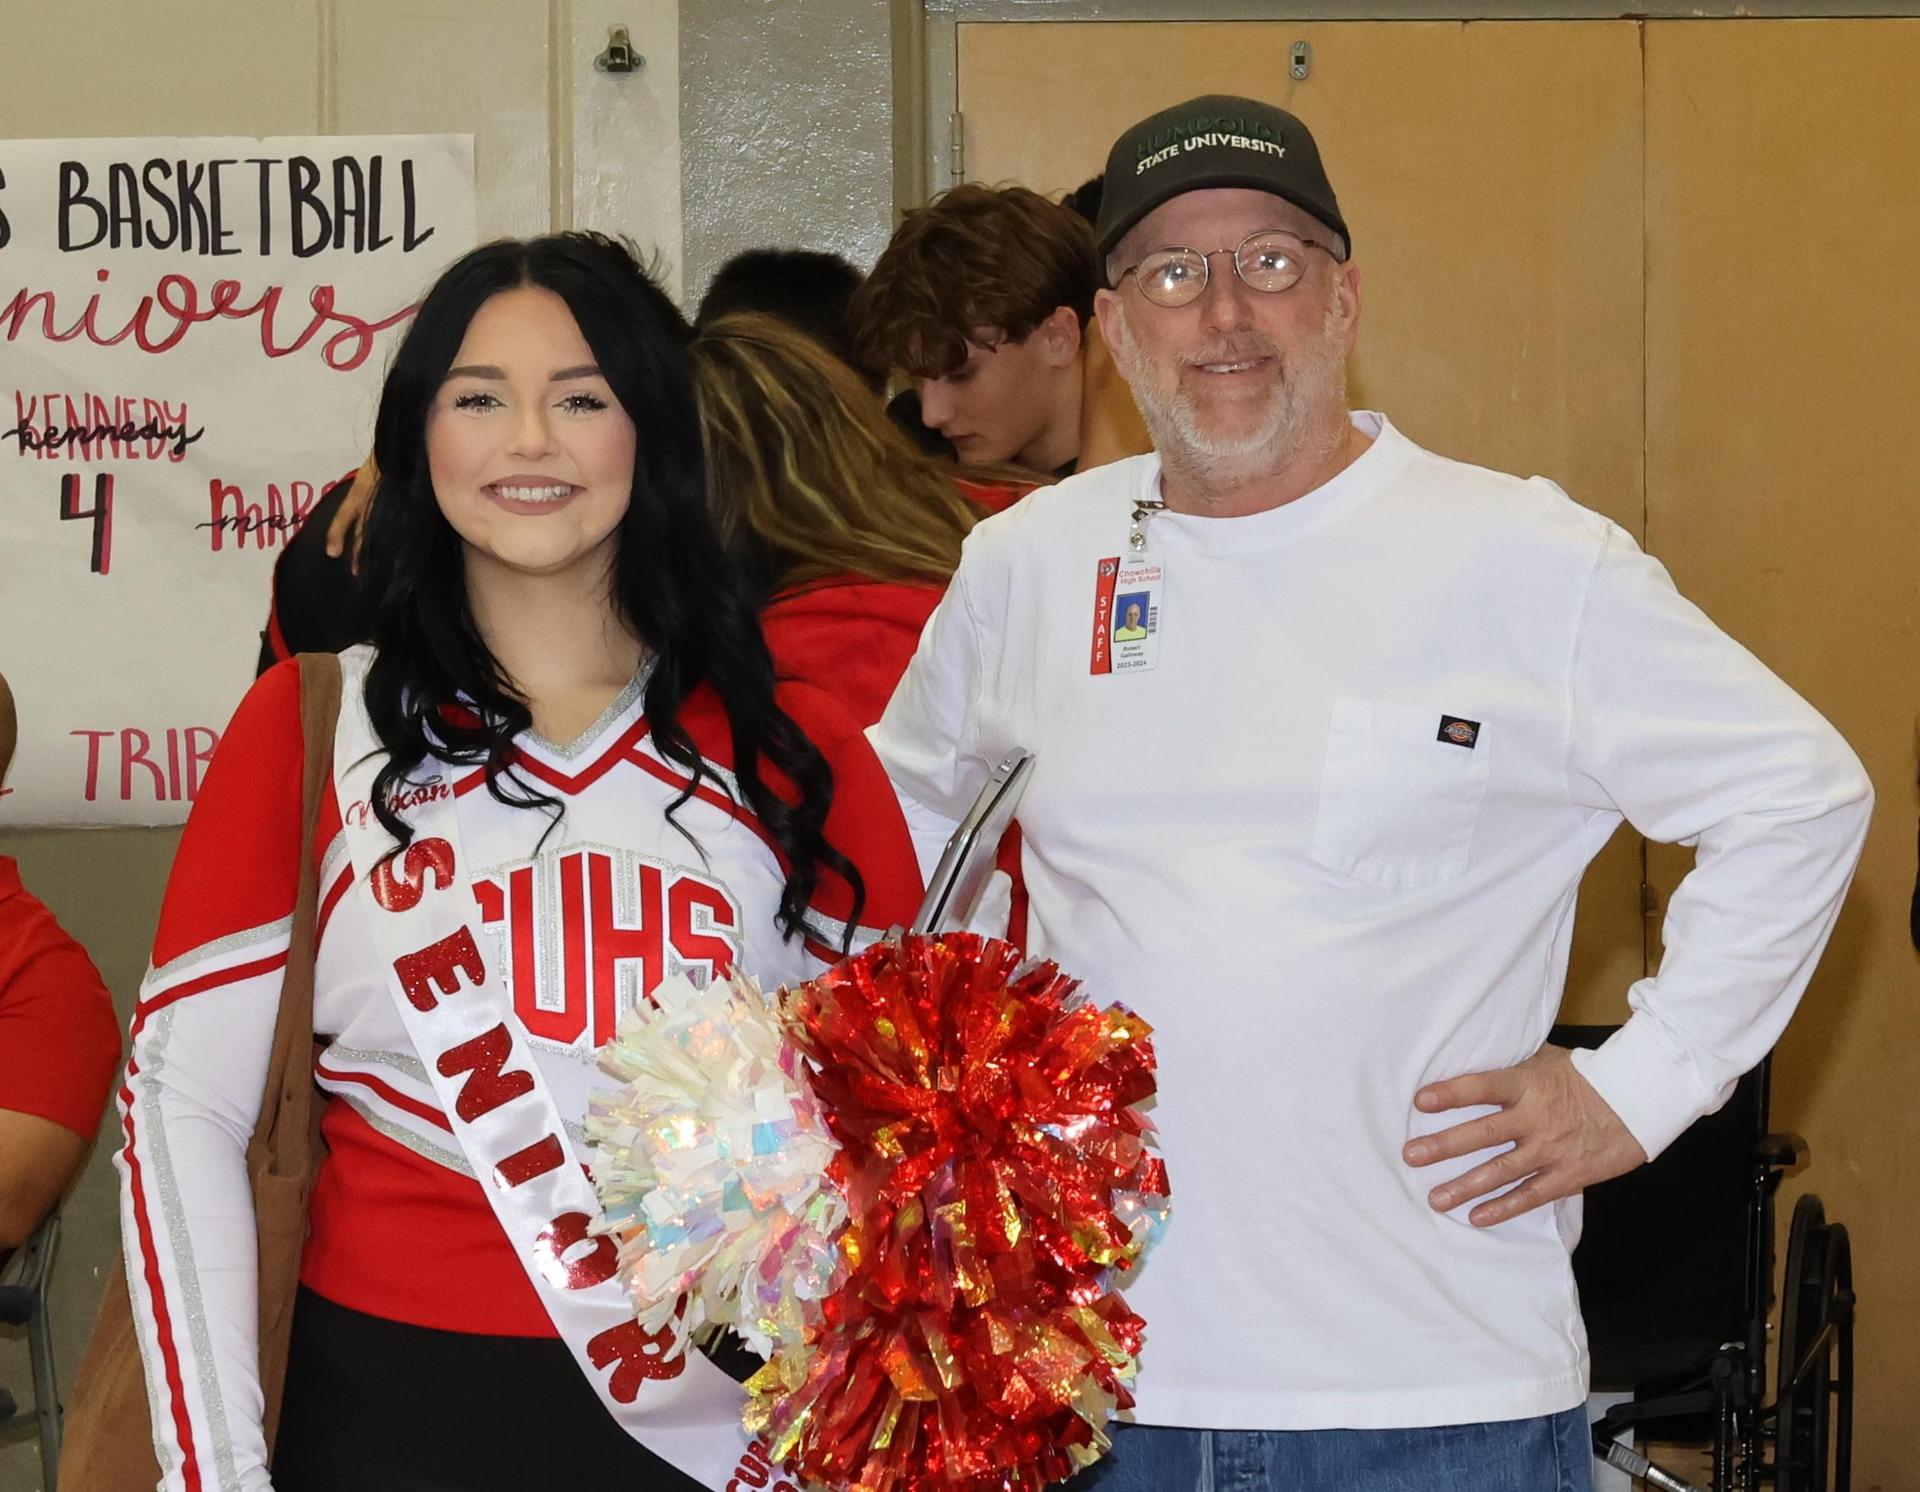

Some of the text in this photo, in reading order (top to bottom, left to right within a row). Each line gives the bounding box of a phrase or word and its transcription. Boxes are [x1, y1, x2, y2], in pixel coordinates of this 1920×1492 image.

[1136, 132, 1286, 175] STATE UNIVERSITY
[58, 155, 435, 257] BASKETBALL
[1, 416, 205, 455] kennedy
[15, 390, 187, 463] KENNEDY
[60, 473, 114, 575] 4
[210, 479, 338, 551] MAR
[1120, 574, 1161, 585] High School
[1096, 596, 1107, 662] STAFF
[371, 837, 688, 1404] SENIOR
